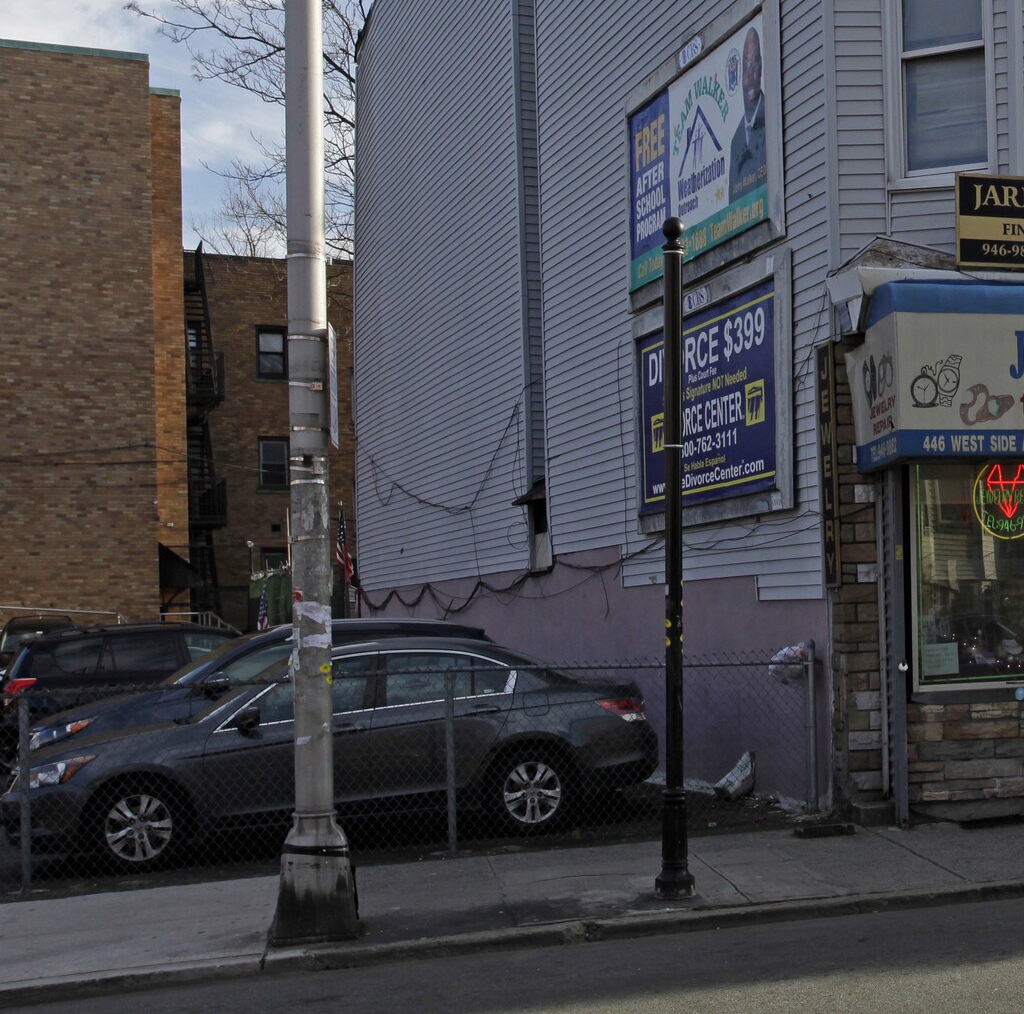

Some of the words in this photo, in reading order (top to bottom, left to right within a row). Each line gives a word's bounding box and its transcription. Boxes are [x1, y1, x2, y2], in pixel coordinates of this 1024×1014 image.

[673, 89, 693, 156] TEAM
[693, 75, 729, 124] WALKER
[635, 114, 665, 172] FREE
[636, 161, 665, 197] AFTER
[678, 156, 725, 201] Weatherization
[636, 185, 666, 220] SCHOOL
[636, 207, 667, 243] PROGRAM
[649, 326, 719, 387] DIRCE
[723, 306, 765, 362] $399
[686, 383, 712, 401] Signature
[712, 375, 725, 390] NOT
[725, 366, 748, 386] Needed
[709, 366, 717, 377] Fee
[870, 395, 896, 419] JEWELRY
[873, 415, 895, 436] REPAIR
[922, 435, 945, 452] 446
[950, 435, 984, 452] WEST
[990, 435, 1017, 452] SIDE
[820, 356, 836, 574] JEWELRY
